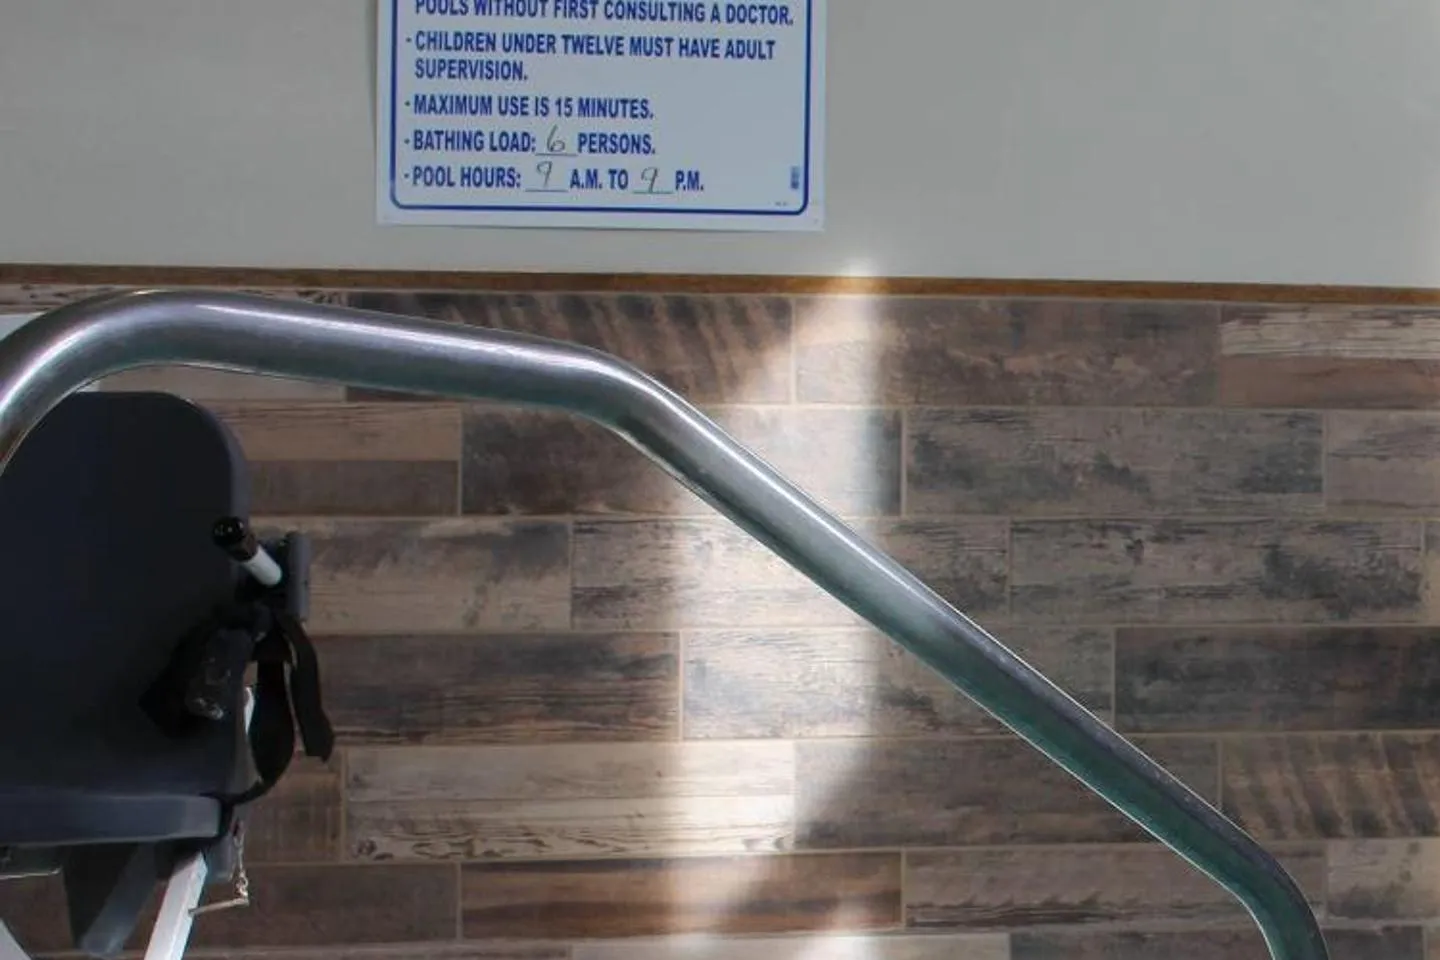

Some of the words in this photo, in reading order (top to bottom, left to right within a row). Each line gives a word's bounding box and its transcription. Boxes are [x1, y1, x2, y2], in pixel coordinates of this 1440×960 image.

[415, 0, 469, 16] POOLS
[474, 0, 548, 18] WITHOUT
[554, 0, 599, 19] FIRST
[604, 0, 705, 22] CONSULTING
[710, 3, 721, 23] A
[726, 4, 794, 25] DOCTOR.
[415, 30, 496, 52] CHILDREN
[502, 33, 556, 54] UNDER
[561, 35, 624, 56] TWELVE
[629, 36, 674, 57] MUST
[678, 38, 720, 58] HAVE
[724, 40, 775, 60] ADULT
[415, 58, 528, 81] SUPERVISION.
[414, 94, 493, 115] MAXIMUM
[498, 96, 529, 116] USE
[535, 96, 550, 117] IS
[555, 97, 573, 118] 15
[577, 97, 655, 119] MINUTES.
[413, 129, 484, 151] BATHING
[489, 131, 536, 152] LOAD:
[546, 124, 566, 153] 6
[577, 132, 656, 154] PERSONS.
[412, 166, 455, 187] POOL
[460, 166, 522, 188] HOURS:
[536, 160, 553, 188] 9
[570, 168, 603, 190] A.M.
[608, 169, 629, 190] TO
[675, 170, 704, 191] P.M.
